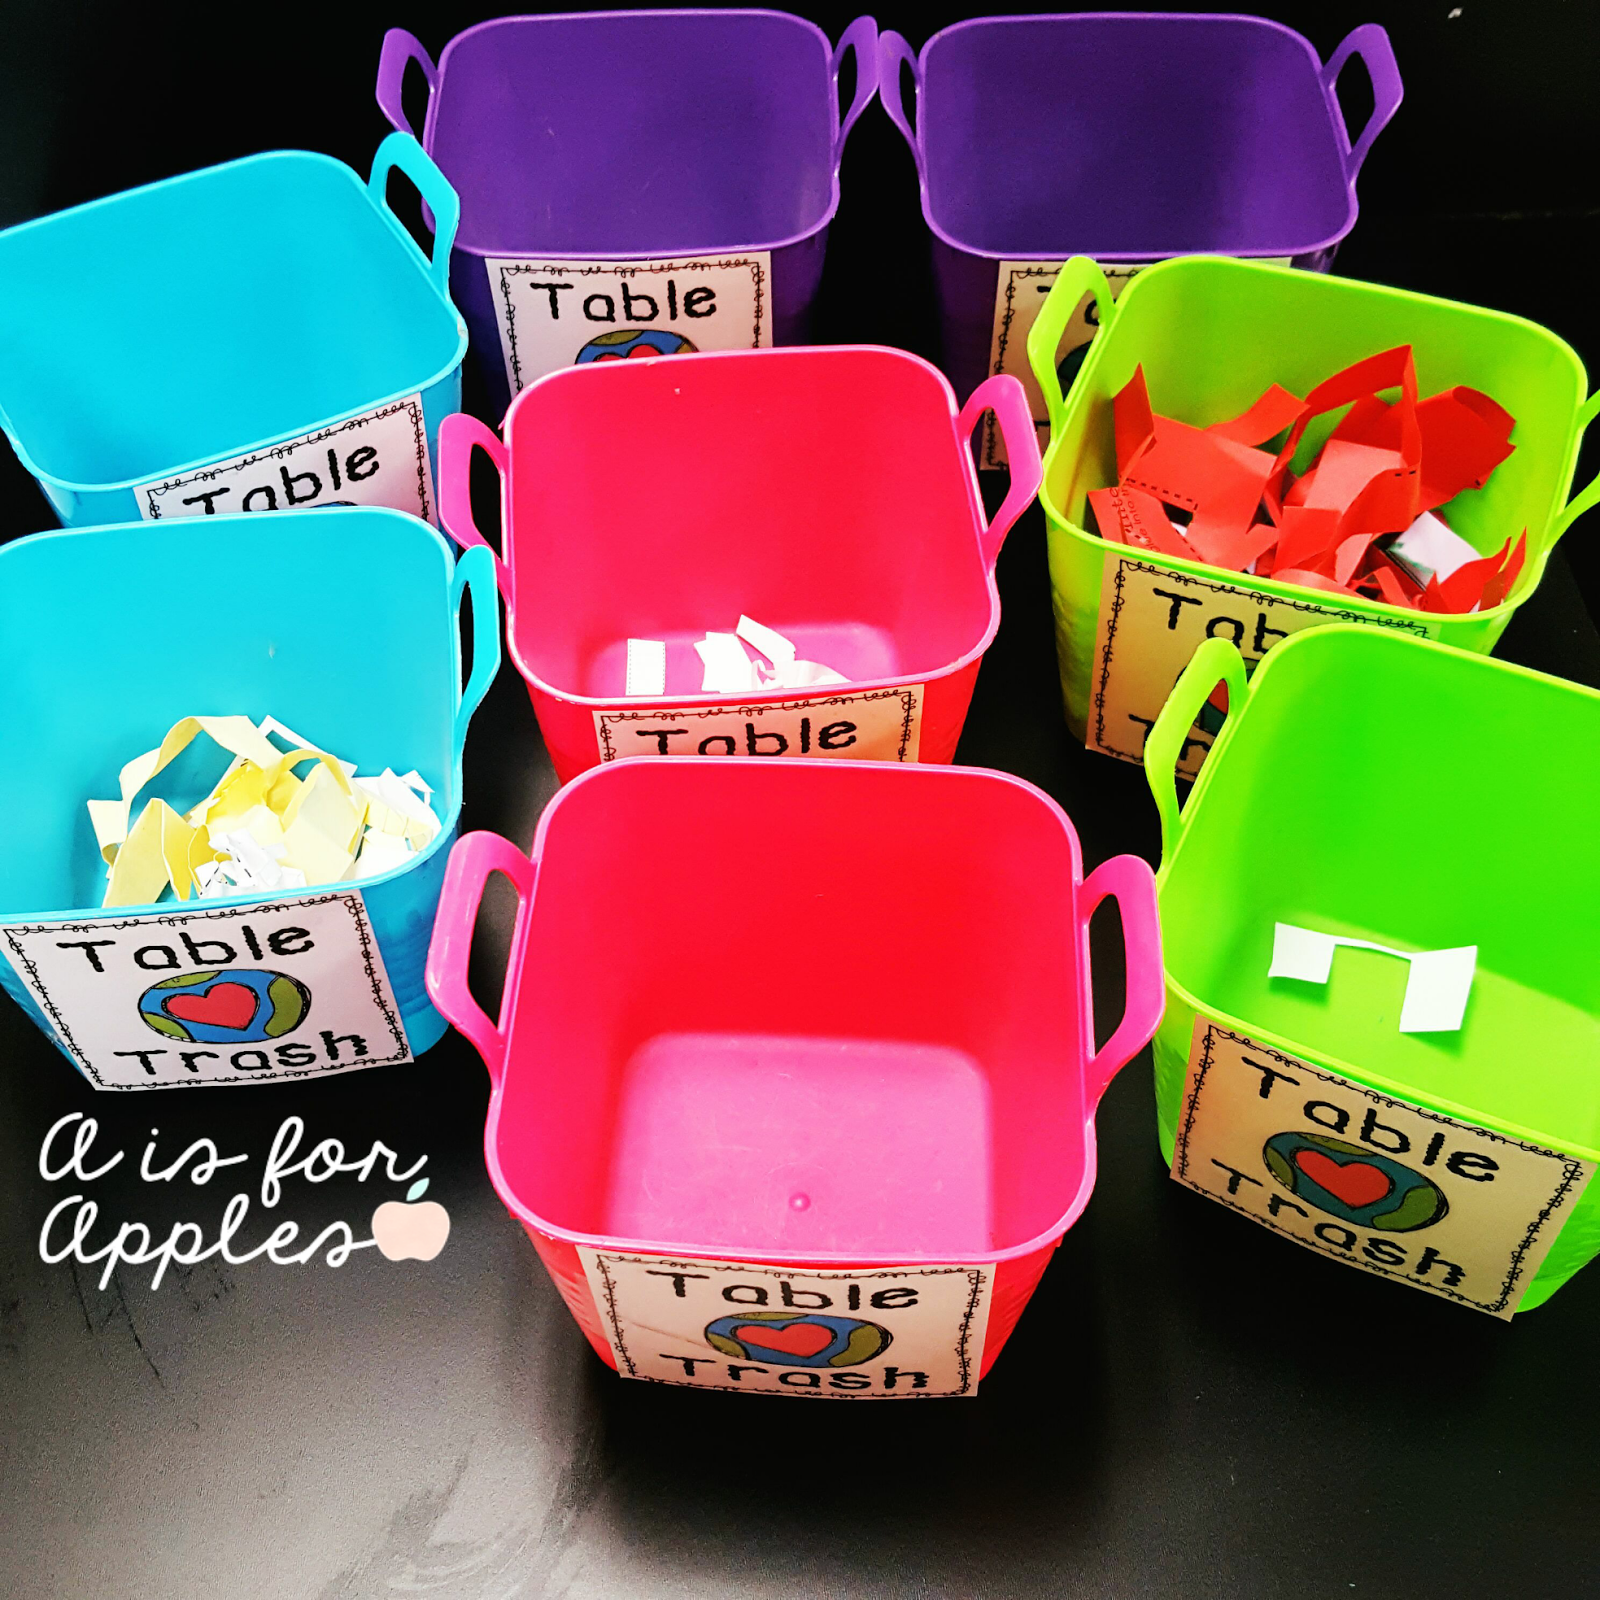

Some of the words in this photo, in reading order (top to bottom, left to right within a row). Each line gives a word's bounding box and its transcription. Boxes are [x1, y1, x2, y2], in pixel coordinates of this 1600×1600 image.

[530, 279, 717, 322] Table
[183, 446, 380, 514] Table
[1153, 588, 1289, 655] Tab
[636, 717, 857, 756] Table
[56, 925, 315, 972] Table
[113, 1031, 370, 1075] Trash
[1241, 1056, 1500, 1183] Table
[1211, 1158, 1466, 1287] Trash
[646, 1270, 919, 1311] Table
[659, 1354, 930, 1390] Trash
